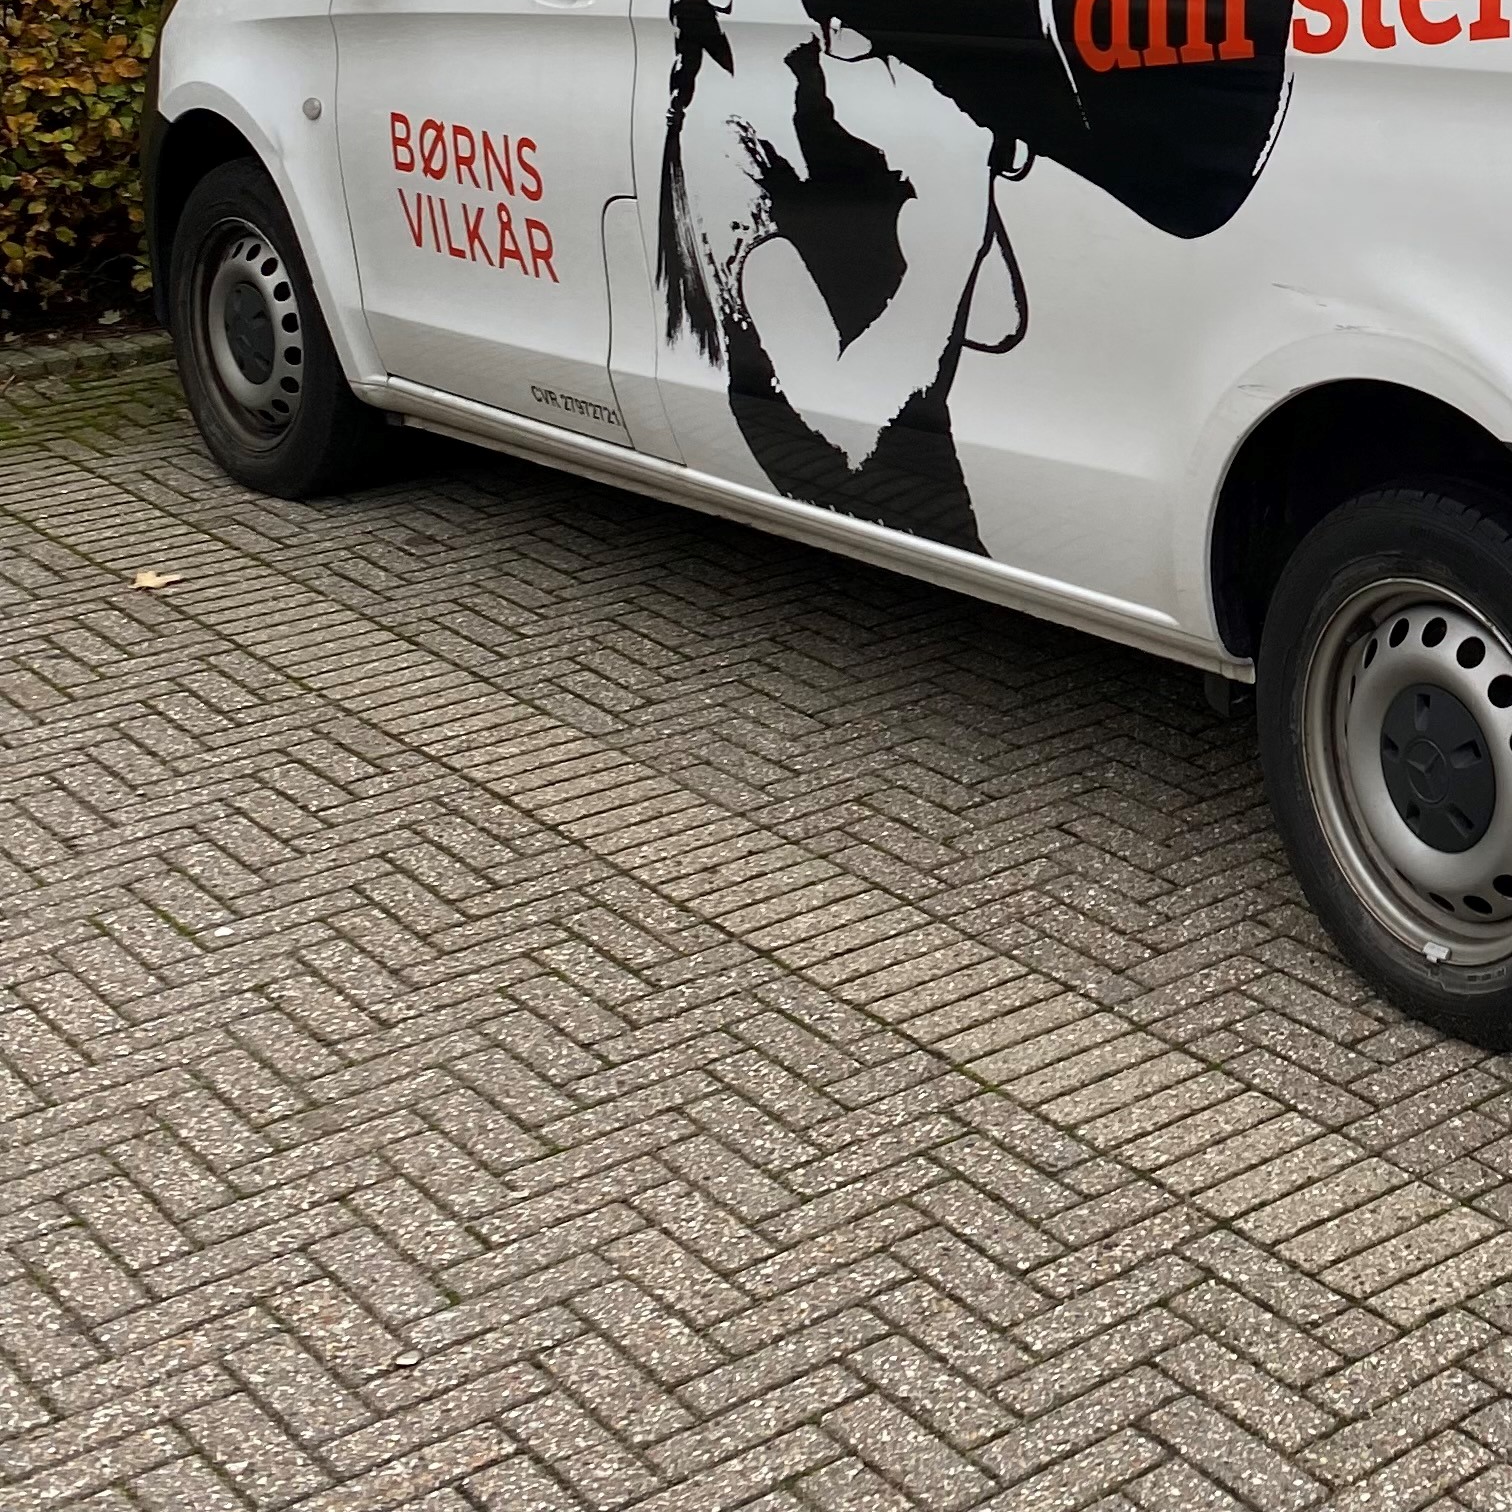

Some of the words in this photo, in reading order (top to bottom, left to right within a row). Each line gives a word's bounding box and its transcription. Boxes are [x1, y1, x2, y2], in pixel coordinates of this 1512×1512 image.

[390, 111, 544, 202] BØRNS
[397, 187, 560, 284] VILKÅR
[530, 385, 561, 409] CVR
